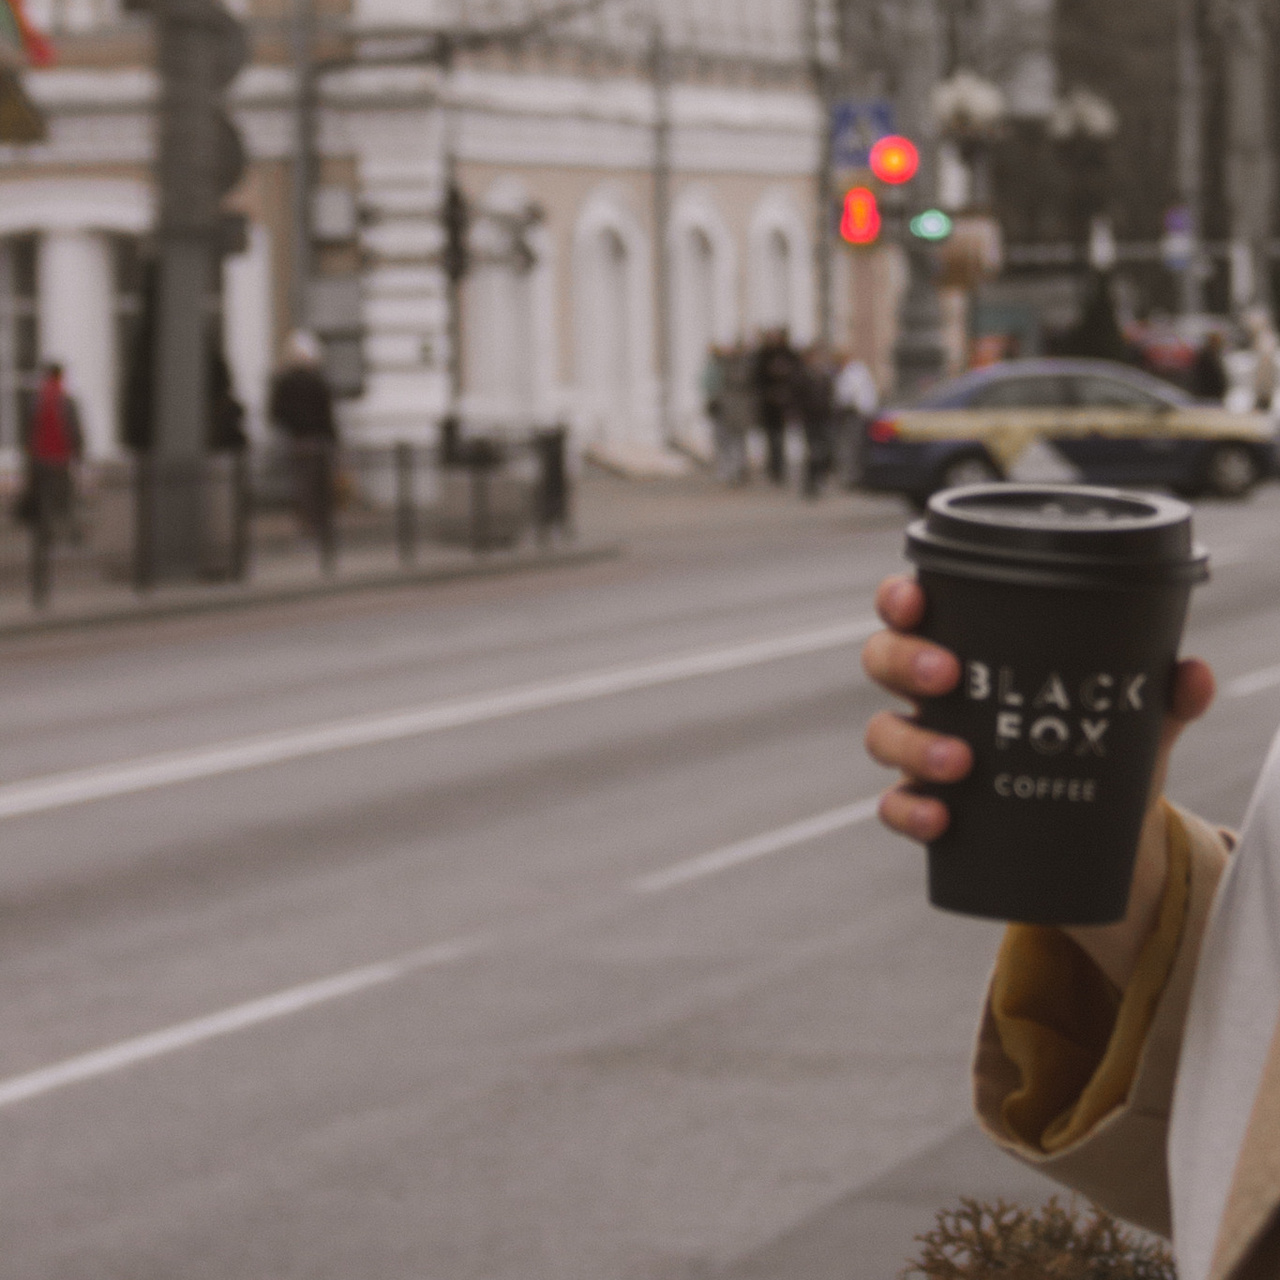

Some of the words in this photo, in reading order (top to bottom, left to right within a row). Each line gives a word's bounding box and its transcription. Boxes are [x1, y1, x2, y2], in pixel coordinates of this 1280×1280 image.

[967, 661, 1148, 711] BLACK
[996, 712, 1108, 755] FOX
[994, 773, 1096, 802] COFFEE
